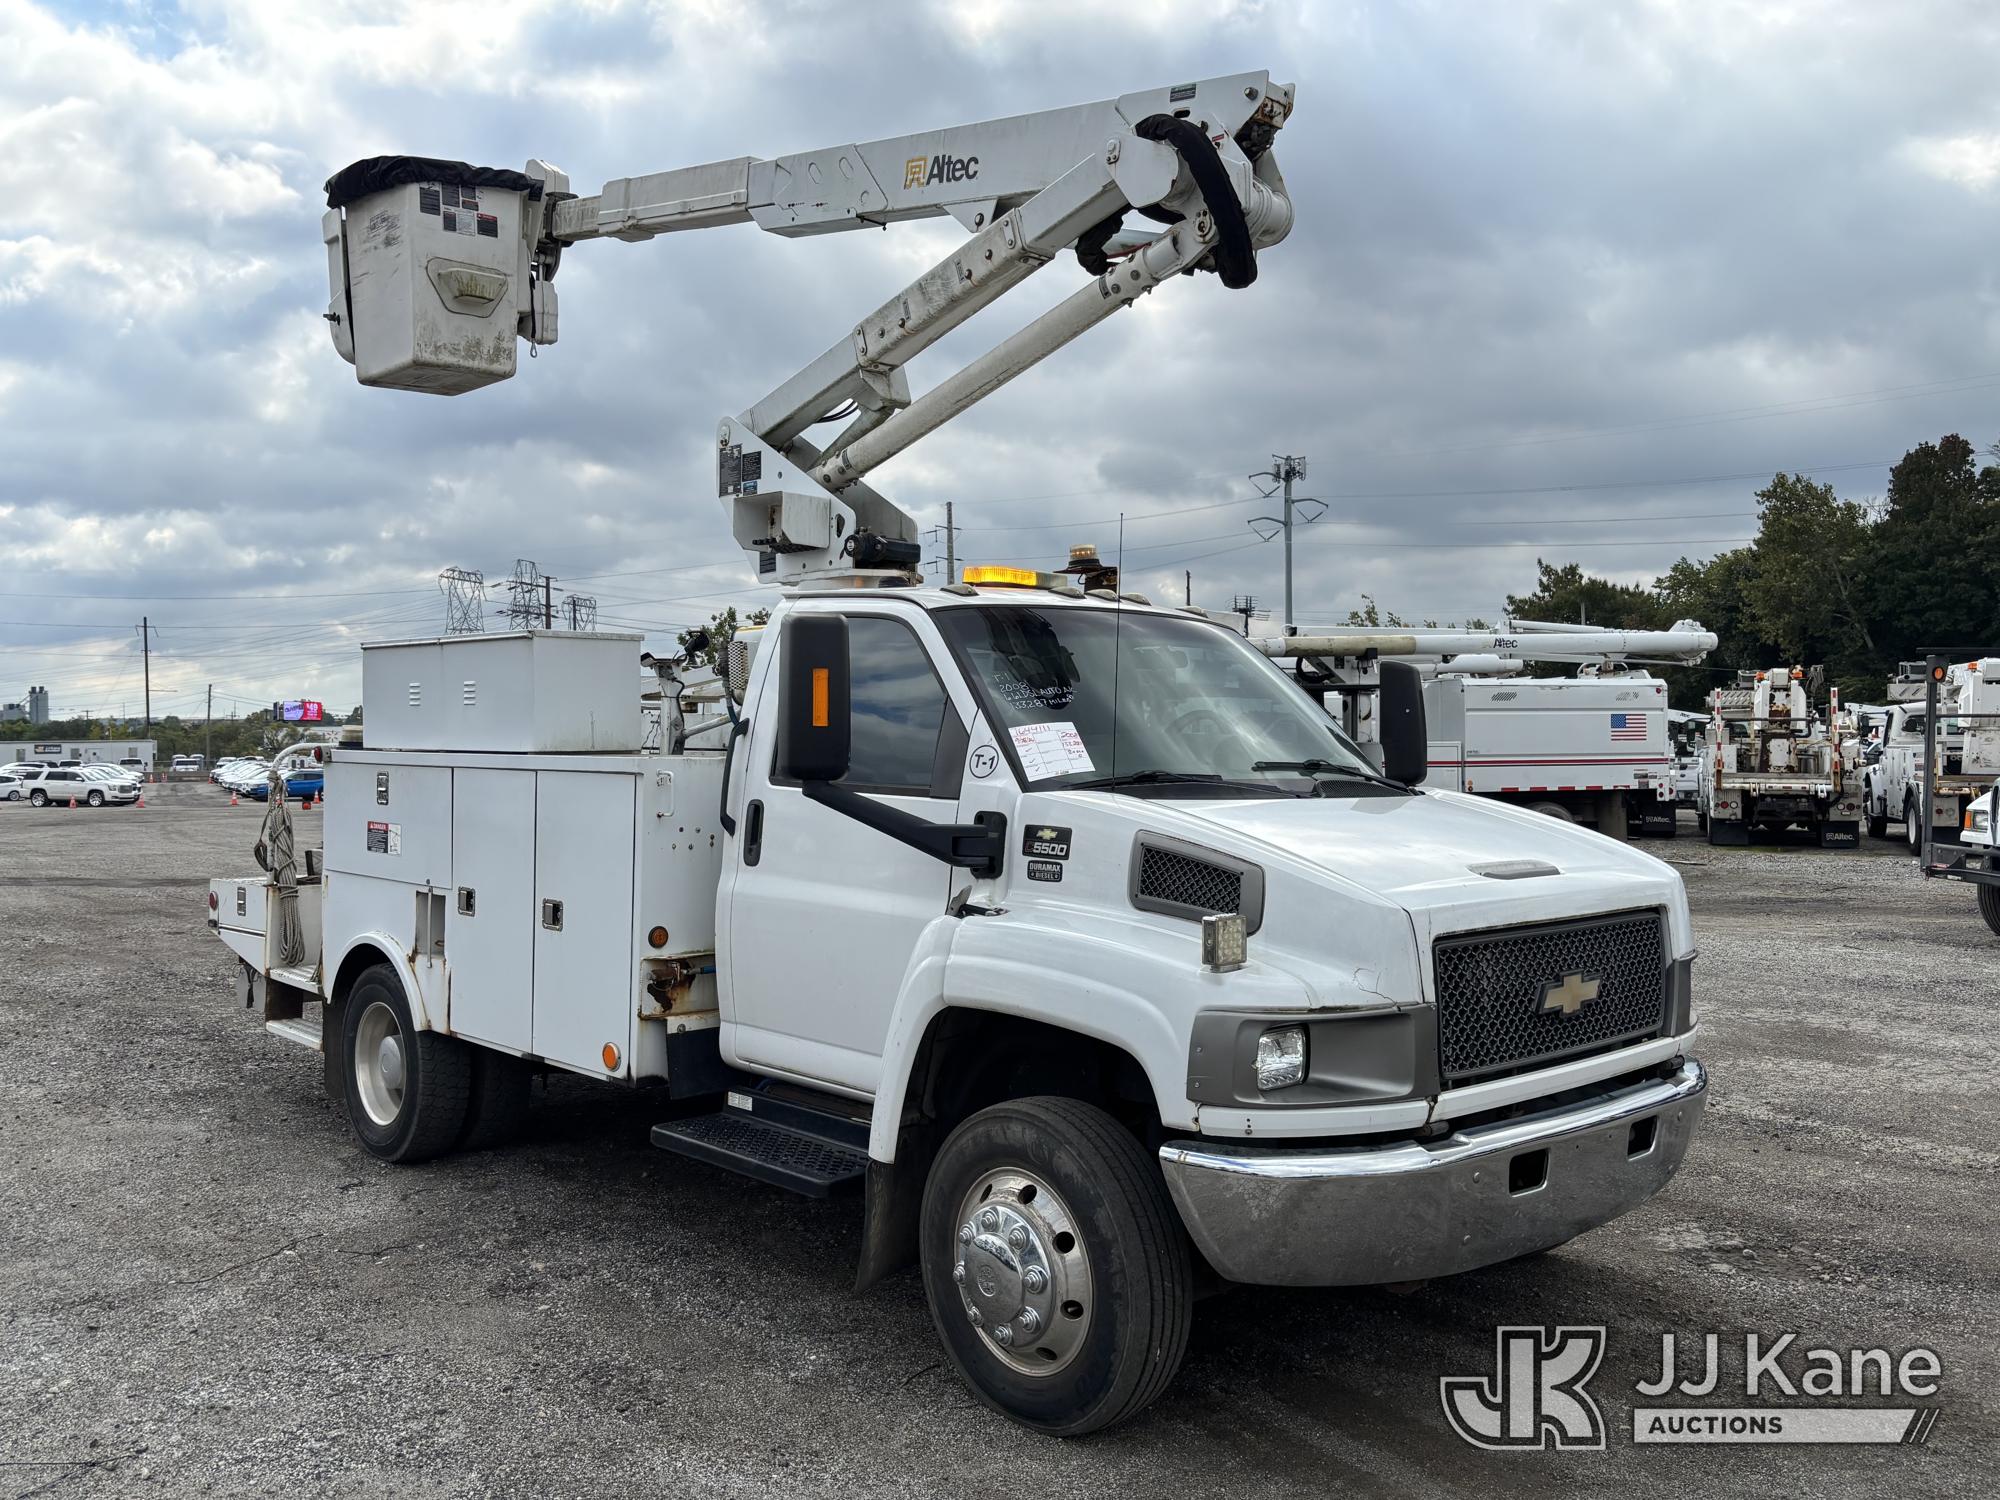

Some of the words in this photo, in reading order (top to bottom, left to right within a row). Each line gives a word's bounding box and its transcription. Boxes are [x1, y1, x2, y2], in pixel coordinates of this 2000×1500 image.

[926, 154, 979, 186] Altec
[1493, 638, 1518, 649] Altec
[1000, 682, 1029, 693] 2008
[975, 754, 996, 769] T-1
[1029, 862, 1061, 873] DURAMAX
[1035, 871, 1054, 879] DIESEL
